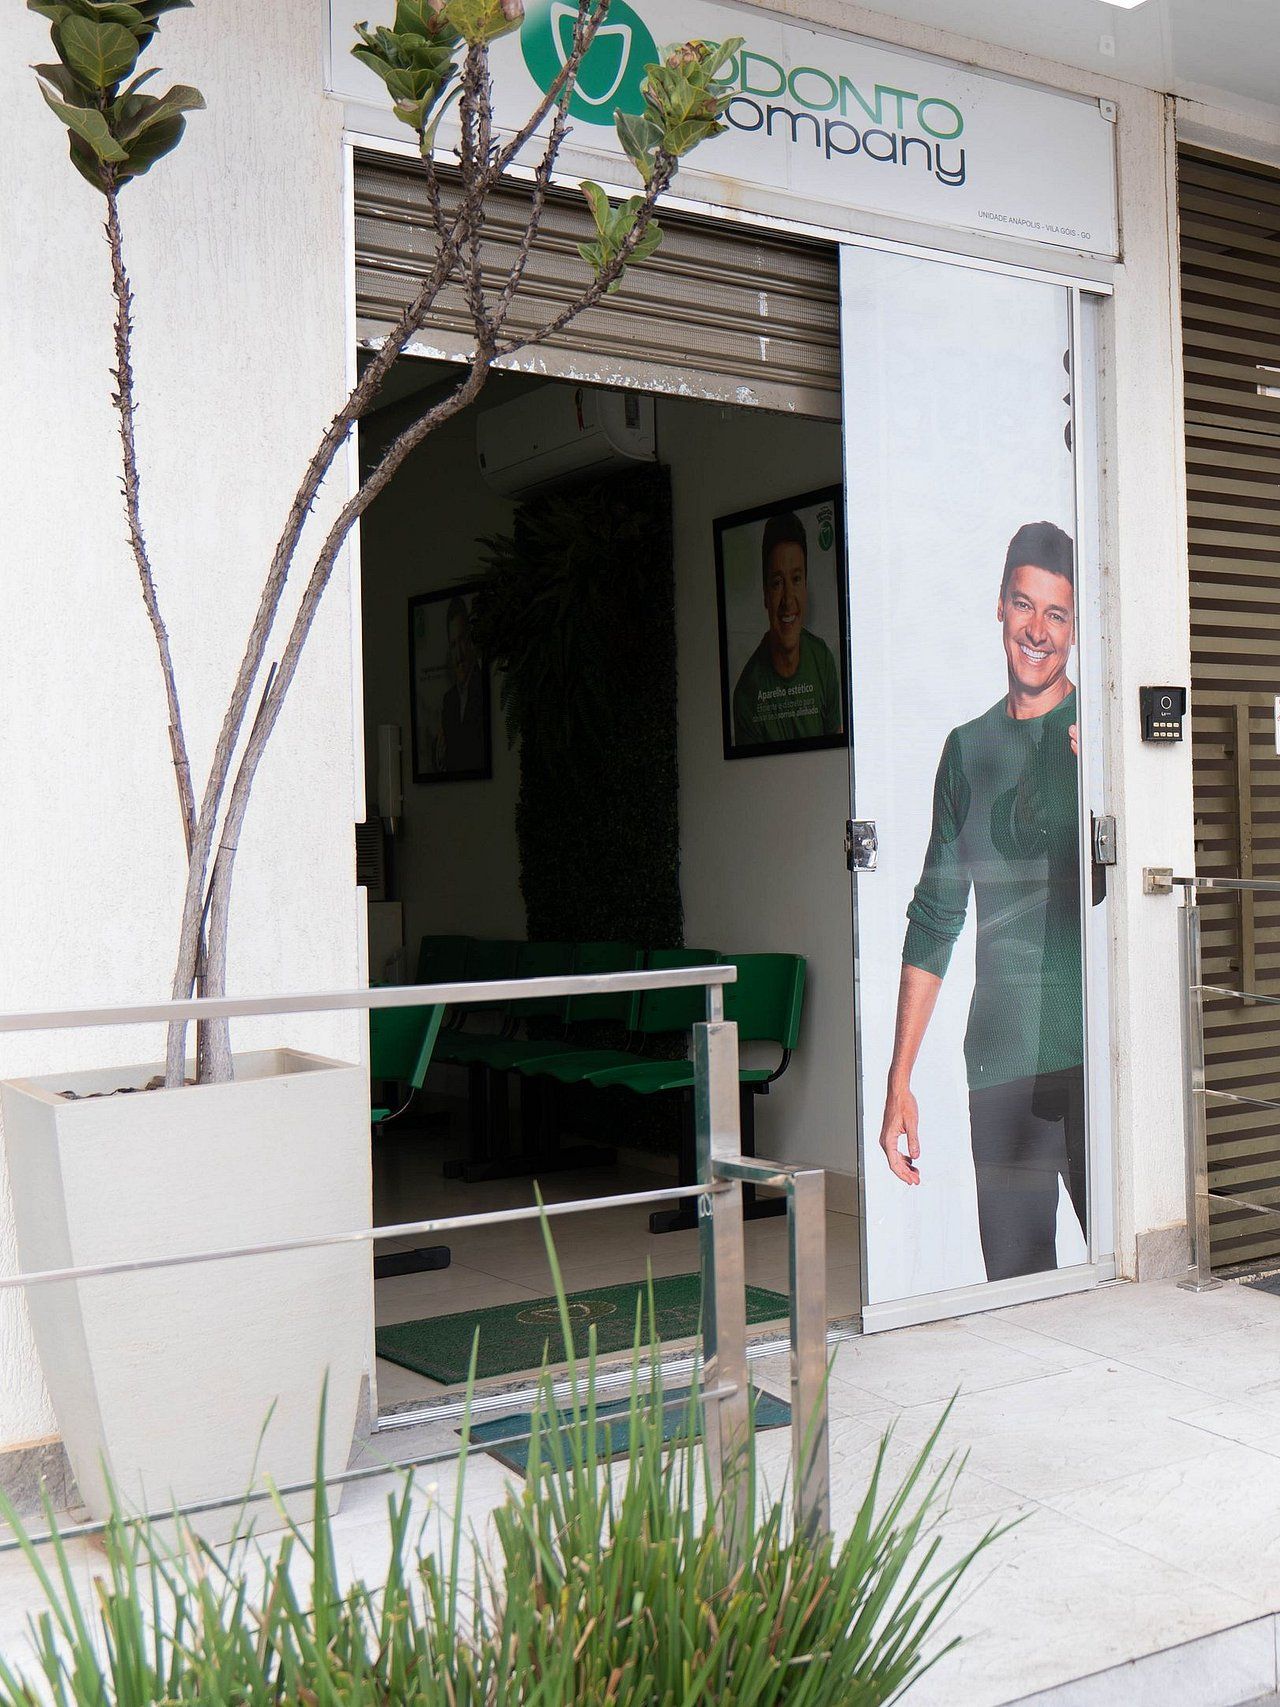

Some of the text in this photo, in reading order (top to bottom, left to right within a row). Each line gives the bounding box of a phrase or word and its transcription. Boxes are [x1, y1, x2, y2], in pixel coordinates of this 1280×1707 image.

[714, 96, 966, 187] ompany
[978, 210, 1008, 223] UNIDADE
[1045, 224, 1060, 233] VILA
[1080, 231, 1091, 240] GO
[757, 683, 814, 702] Aparelho estético
